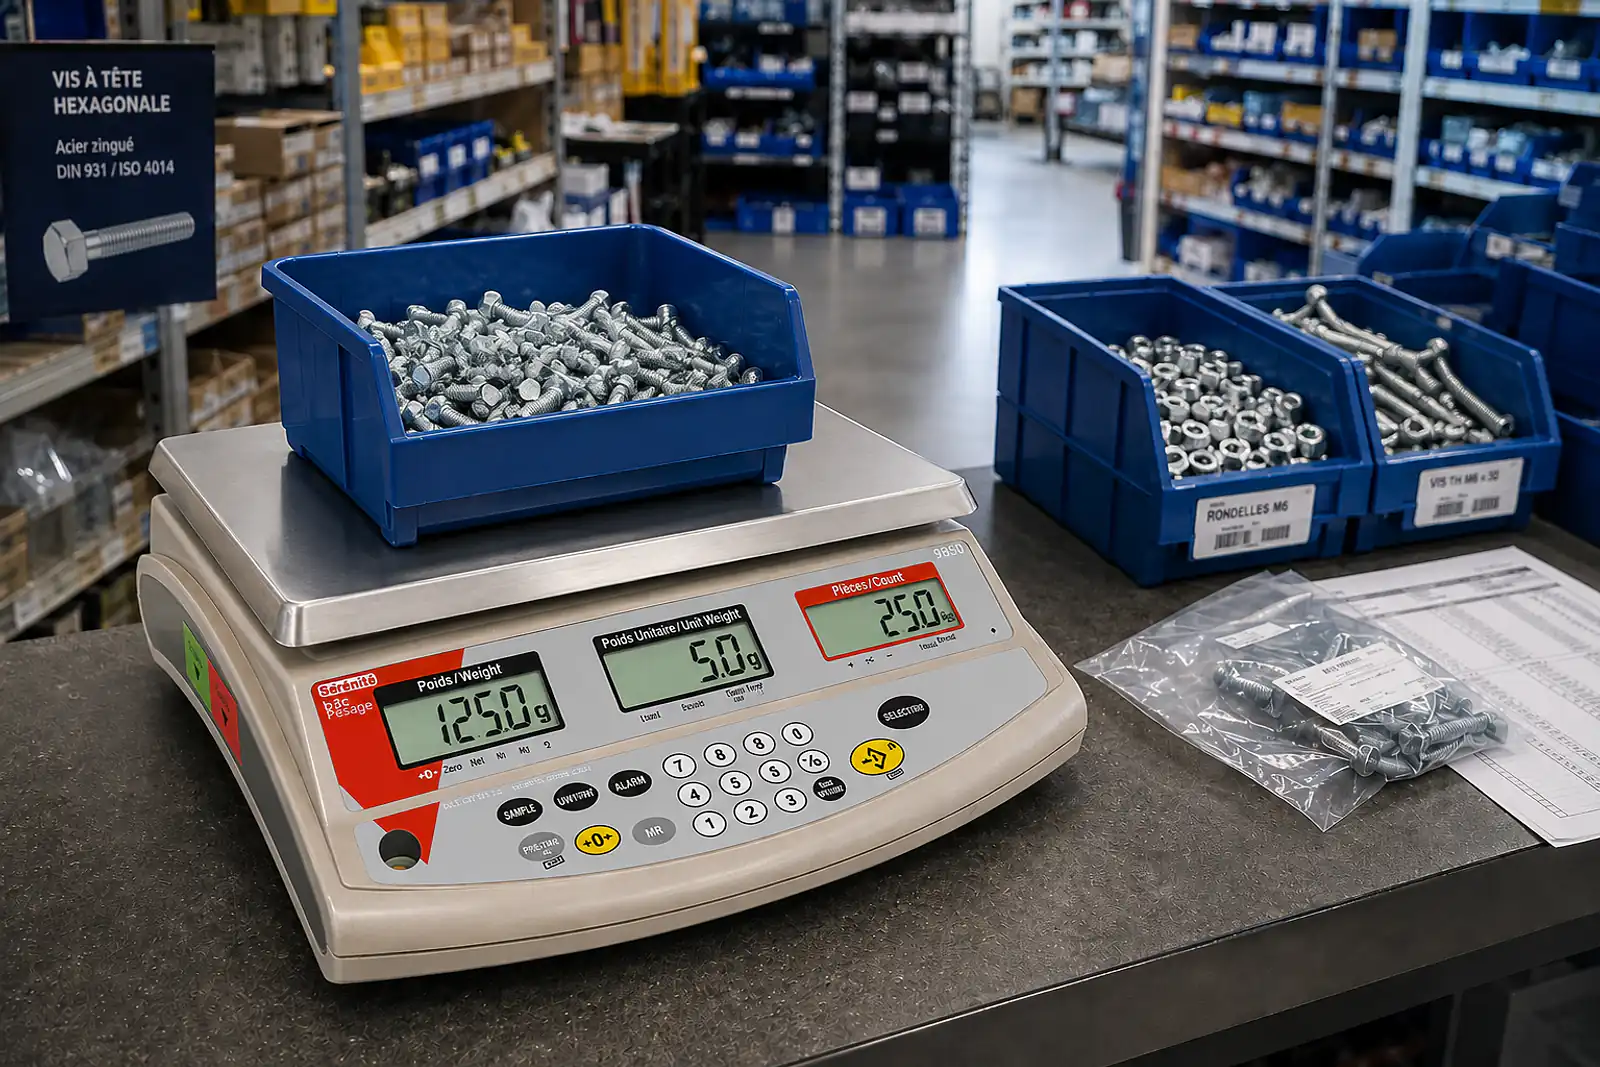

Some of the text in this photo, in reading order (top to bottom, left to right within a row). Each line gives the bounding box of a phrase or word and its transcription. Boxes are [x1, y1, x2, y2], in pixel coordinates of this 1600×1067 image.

[52, 65, 143, 89] VIS À TÊTE
[53, 95, 171, 115] HEXAGONALE
[55, 136, 134, 156] Acier zingué
[57, 160, 175, 179] DIN 931 / ISO 4014
[1207, 500, 1289, 522] RONDELLES M6
[601, 634, 634, 649] Poids
[703, 608, 742, 625] Weight
[792, 728, 803, 740] 0
[714, 749, 727, 761] 8
[673, 759, 683, 773] 7
[730, 777, 741, 789] 5
[690, 788, 701, 801] 4
[785, 794, 797, 806] 3
[503, 803, 537, 821] SAMPLE
[744, 806, 758, 819] 2
[705, 817, 715, 829] 1
[644, 825, 664, 839] MR
